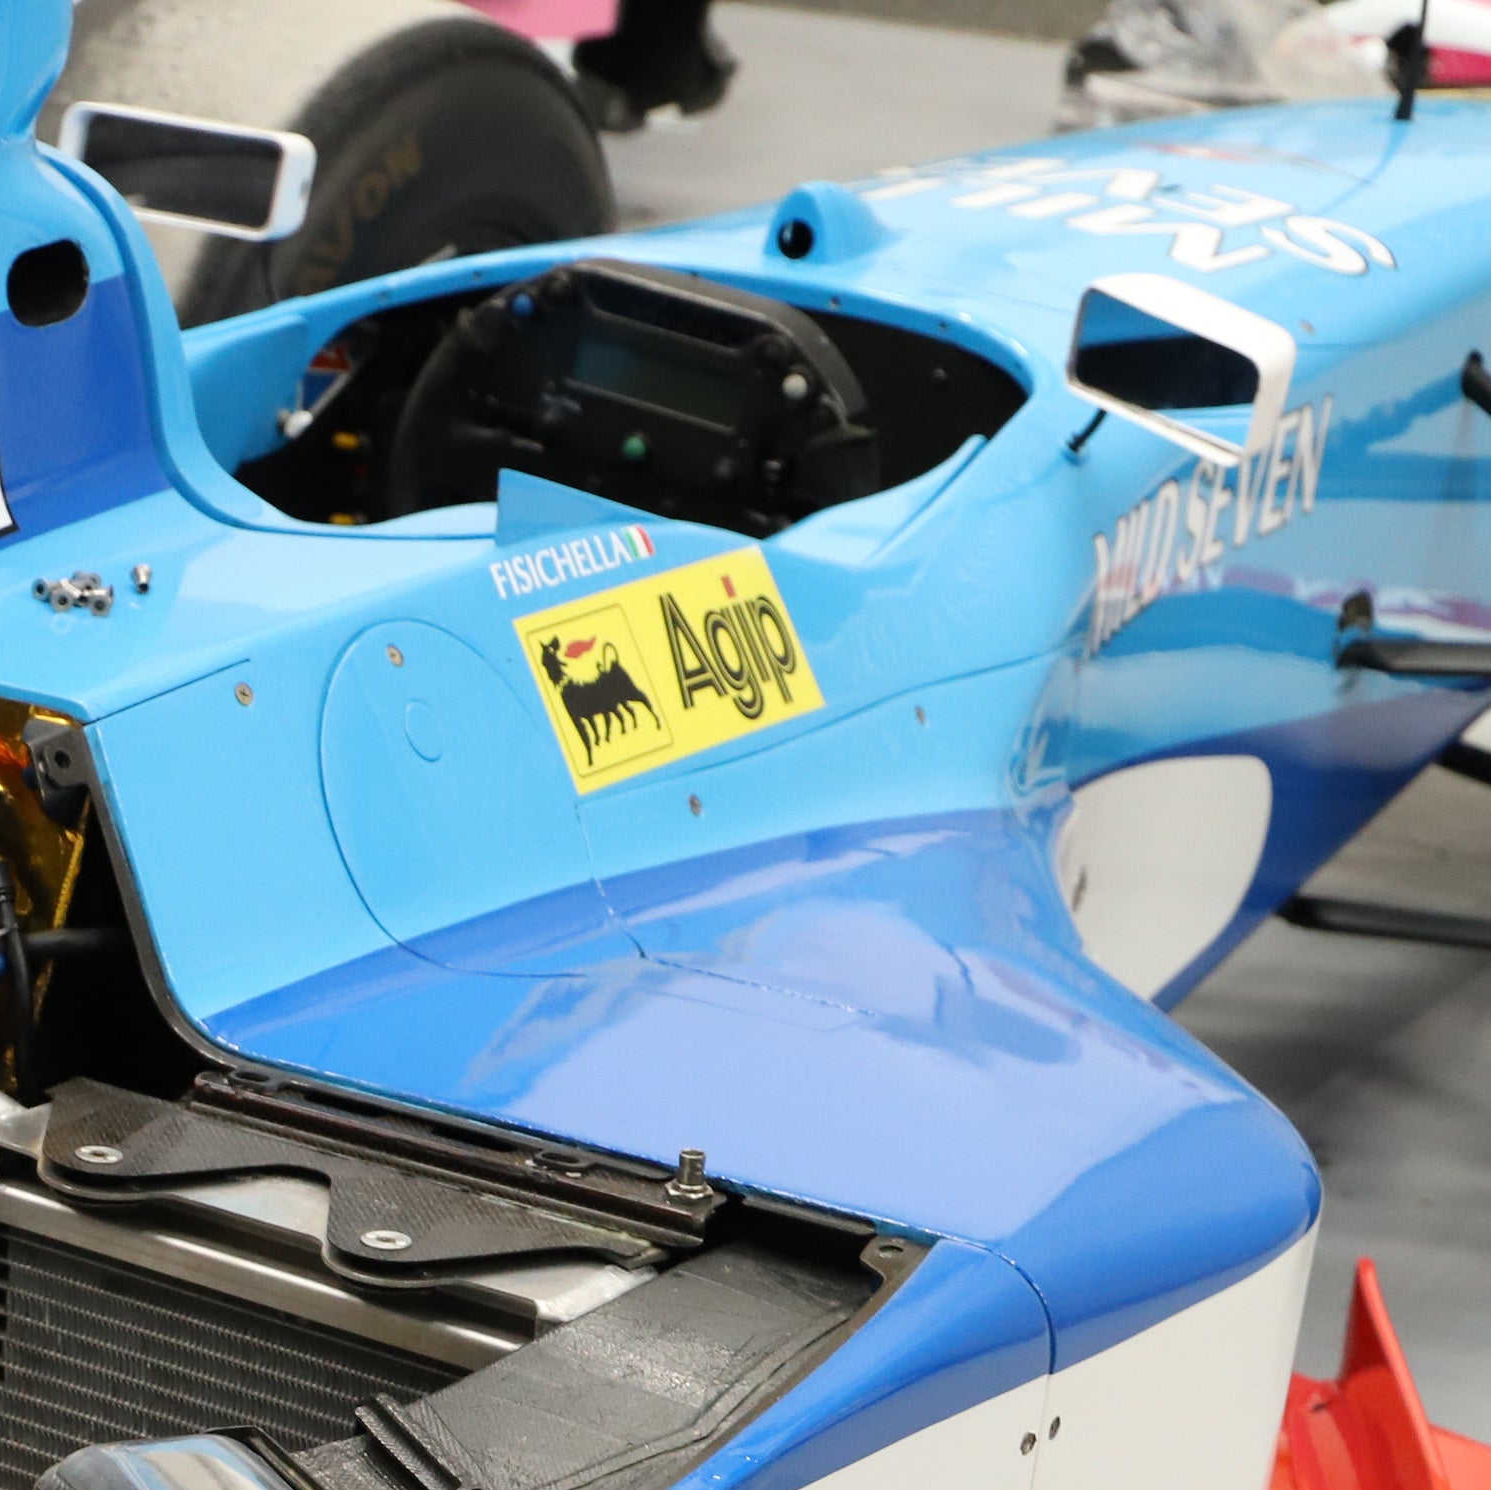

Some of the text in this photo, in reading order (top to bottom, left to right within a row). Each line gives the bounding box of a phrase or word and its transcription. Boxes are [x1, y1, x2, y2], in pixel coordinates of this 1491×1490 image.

[489, 531, 633, 600] FISICHELLA
[1077, 392, 1333, 669] MILD SEVEN
[659, 574, 797, 720] Agip
